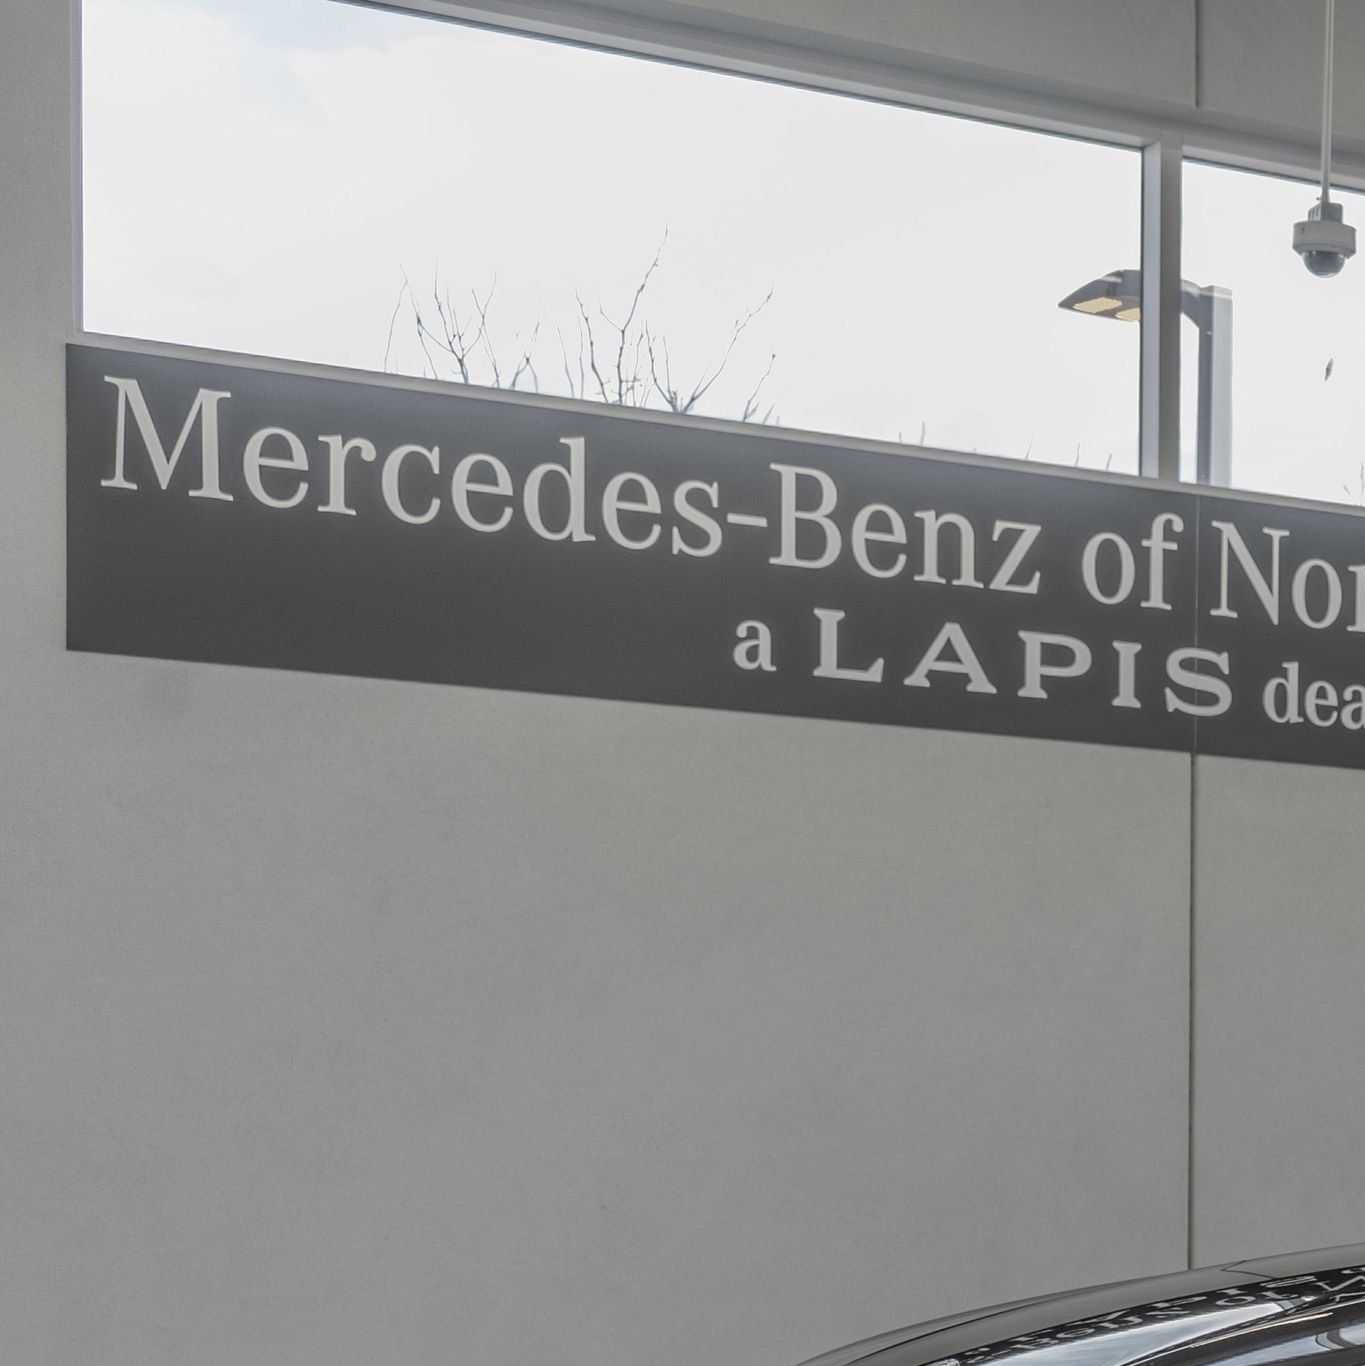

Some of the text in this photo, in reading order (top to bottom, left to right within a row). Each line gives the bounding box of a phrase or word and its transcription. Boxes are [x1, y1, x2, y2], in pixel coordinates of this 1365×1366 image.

[101, 375, 1041, 595] Mercedes-Benz
[1081, 512, 1185, 611] of
[733, 620, 777, 672] a
[812, 607, 1232, 717] LAPIS
